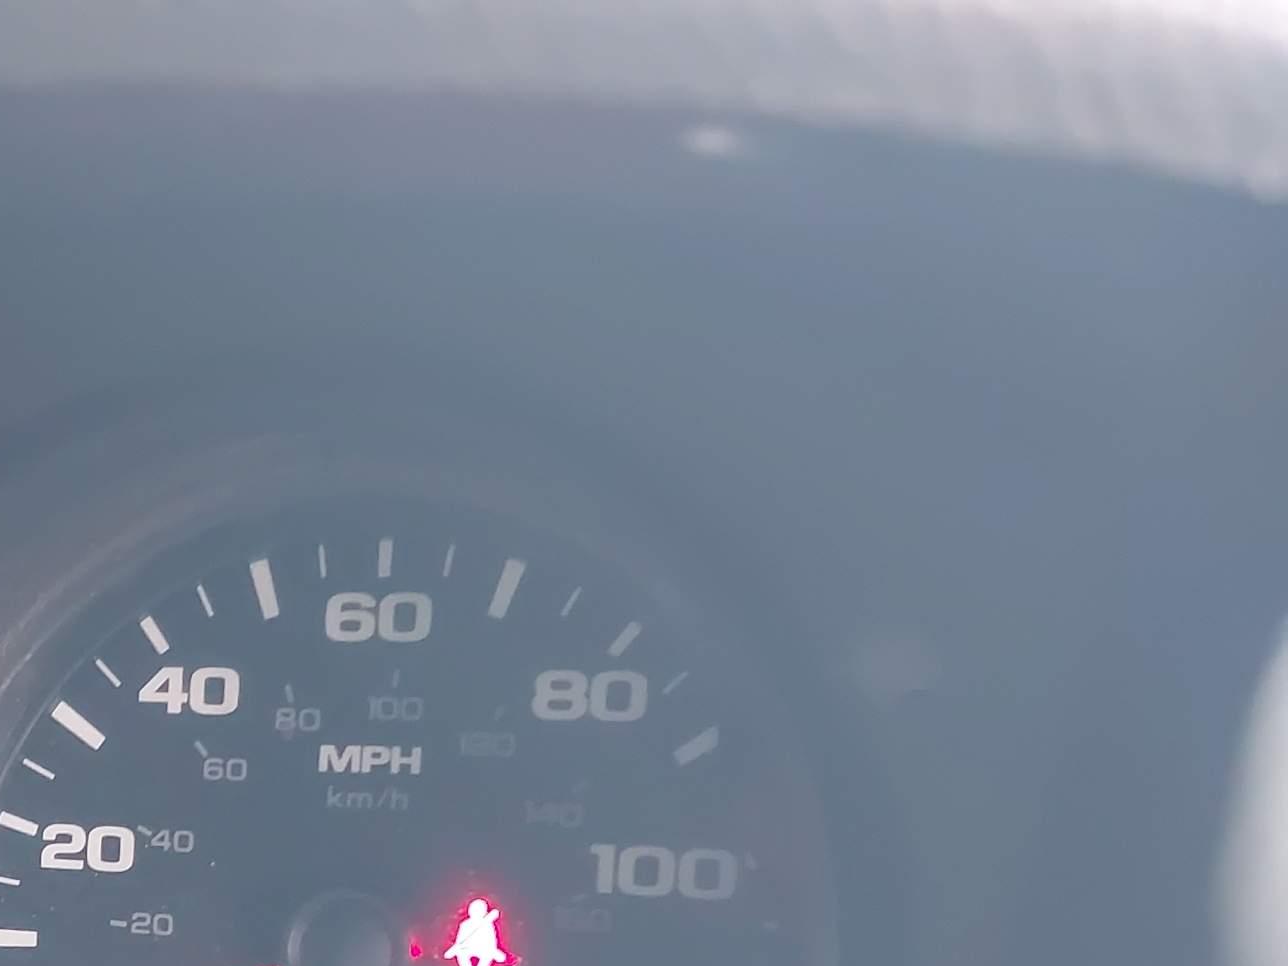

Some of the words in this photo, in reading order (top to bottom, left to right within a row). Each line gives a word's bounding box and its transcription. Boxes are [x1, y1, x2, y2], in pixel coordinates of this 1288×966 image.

[324, 591, 433, 643] 60
[137, 665, 241, 716] 40
[531, 669, 649, 722] 80
[275, 707, 322, 733] 80
[202, 757, 248, 782] 60
[317, 744, 423, 775] MPH
[326, 784, 410, 812] km/h
[40, 822, 136, 873] 20
[150, 829, 195, 854] 40
[589, 843, 739, 901] 100
[130, 912, 175, 936] 20
